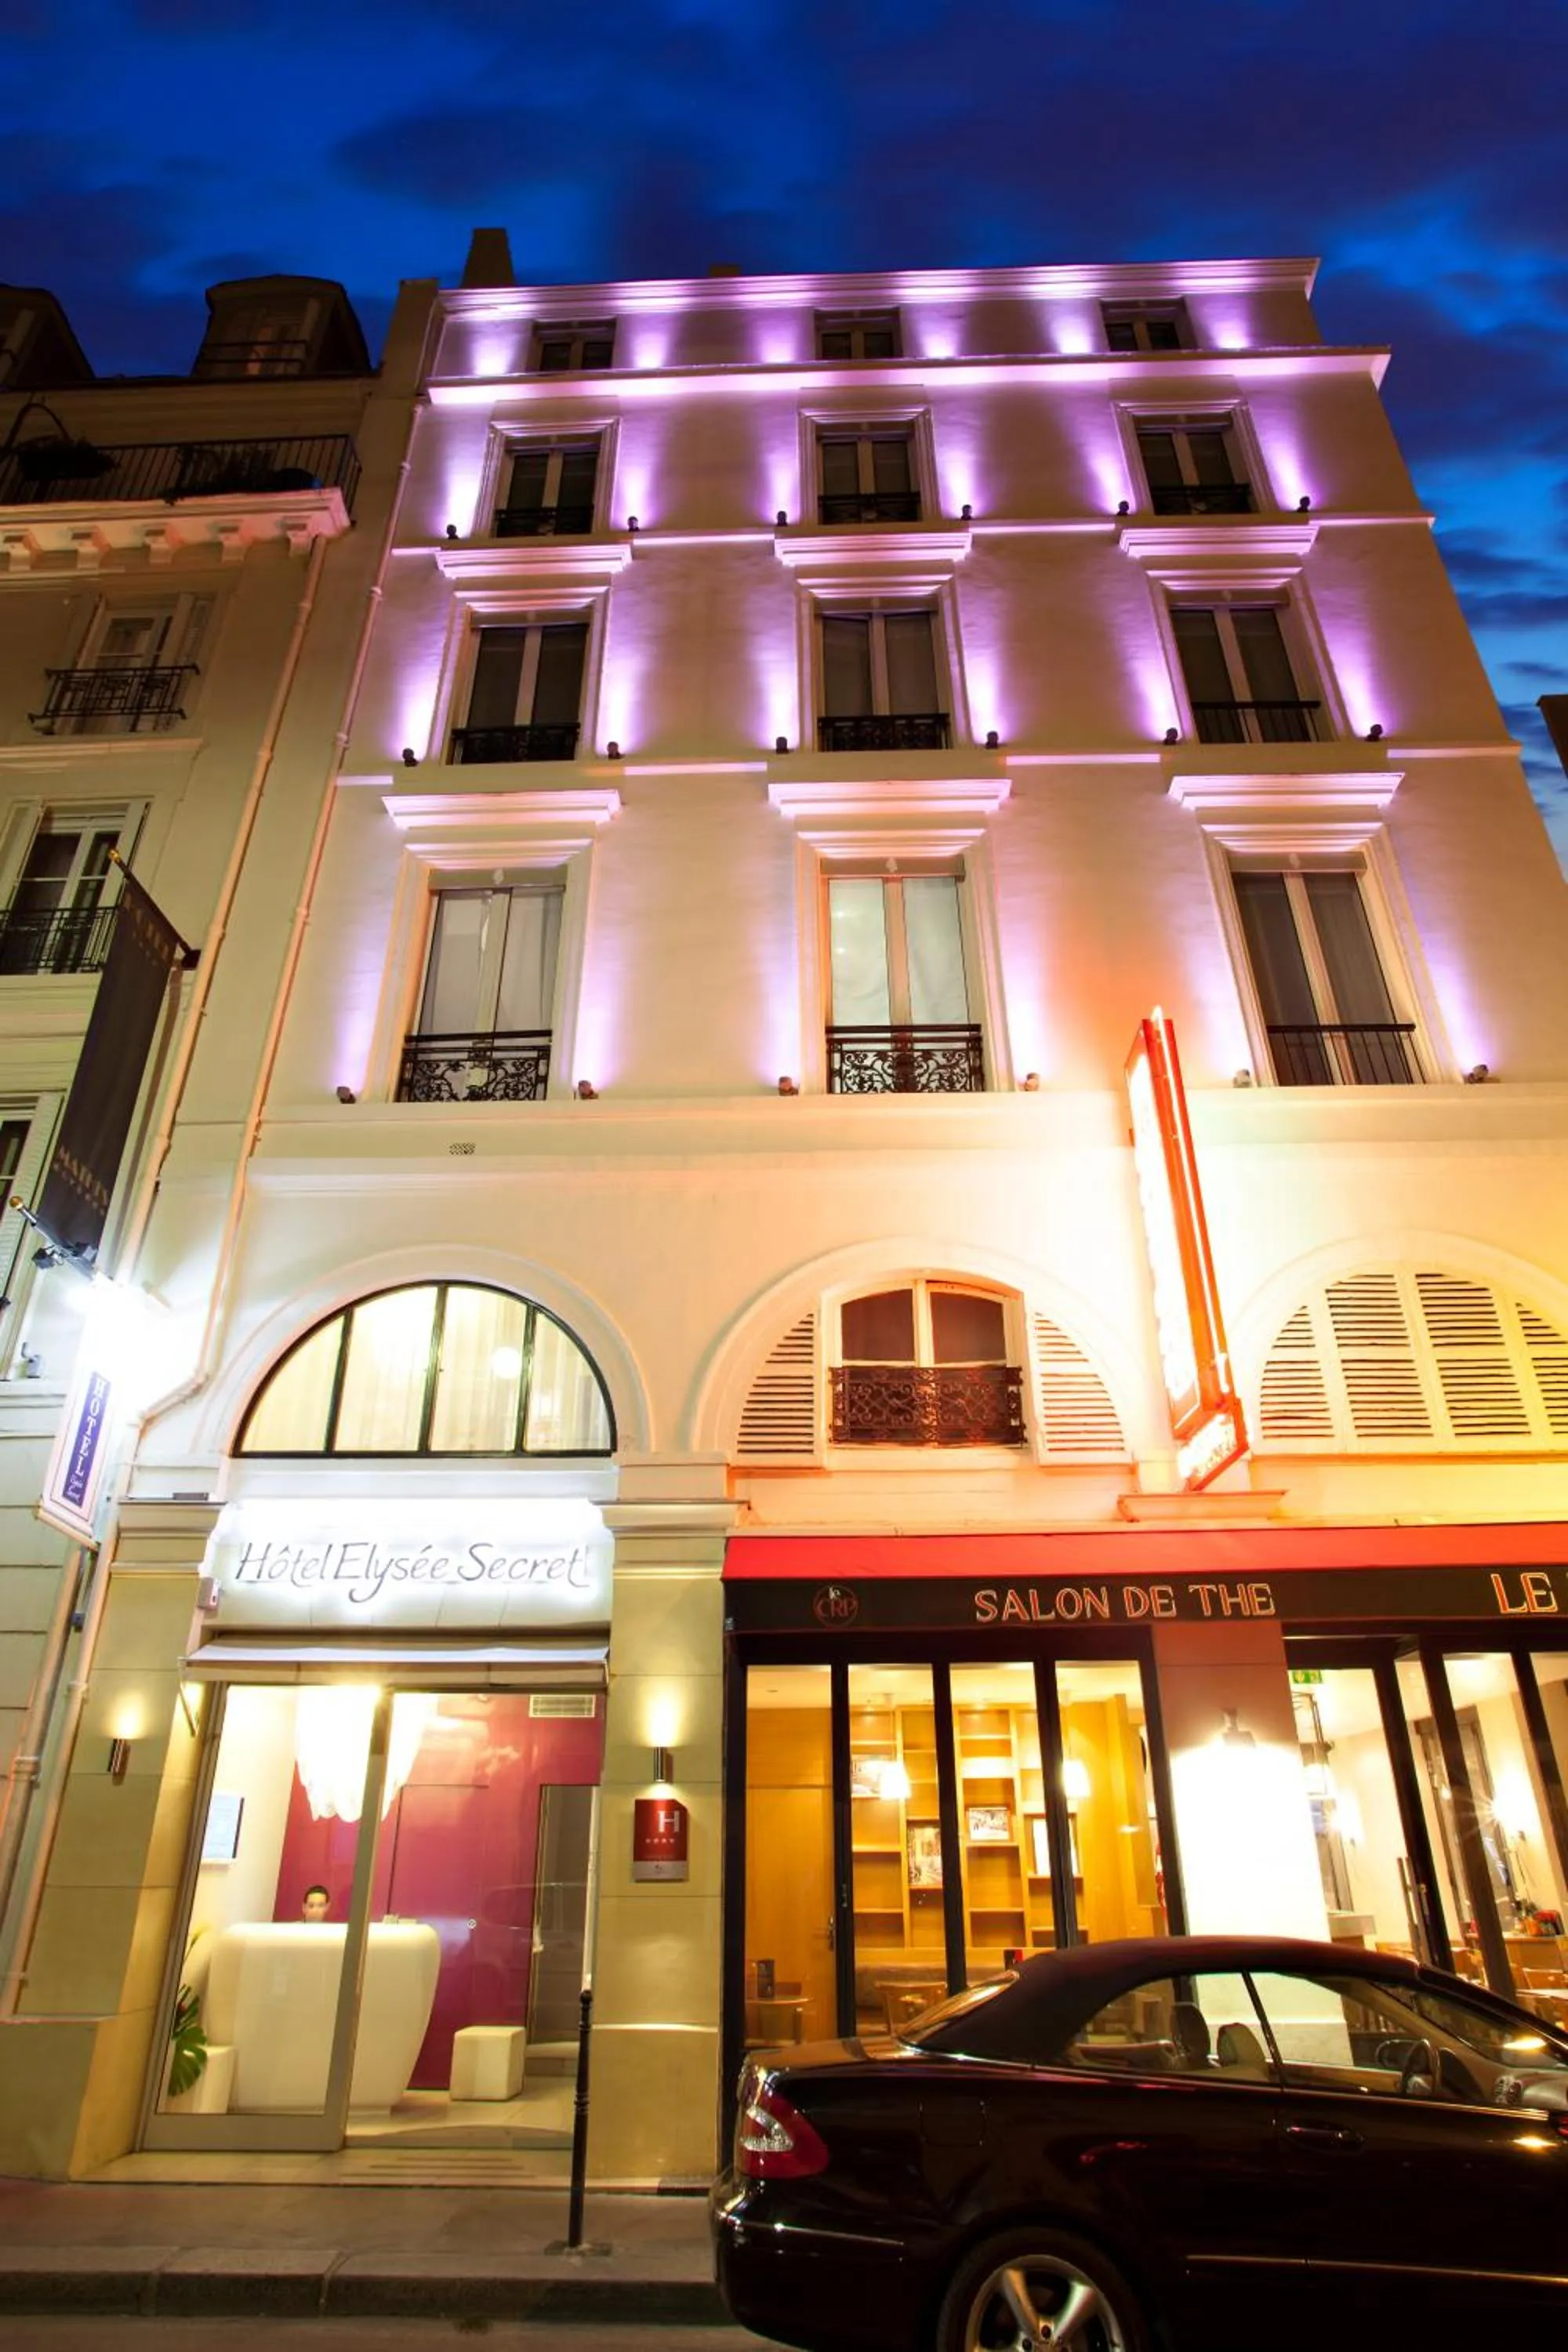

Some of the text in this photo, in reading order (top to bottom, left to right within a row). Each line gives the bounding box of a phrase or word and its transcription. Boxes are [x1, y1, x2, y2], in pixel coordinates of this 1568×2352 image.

[74, 1378, 105, 1475] HOTEL
[235, 1542, 590, 1603] Hôtel Elysée Secret
[975, 1583, 1276, 1623] SALON DE THE
[1490, 1573, 1558, 1614] LE
[659, 1810, 680, 1832] H
